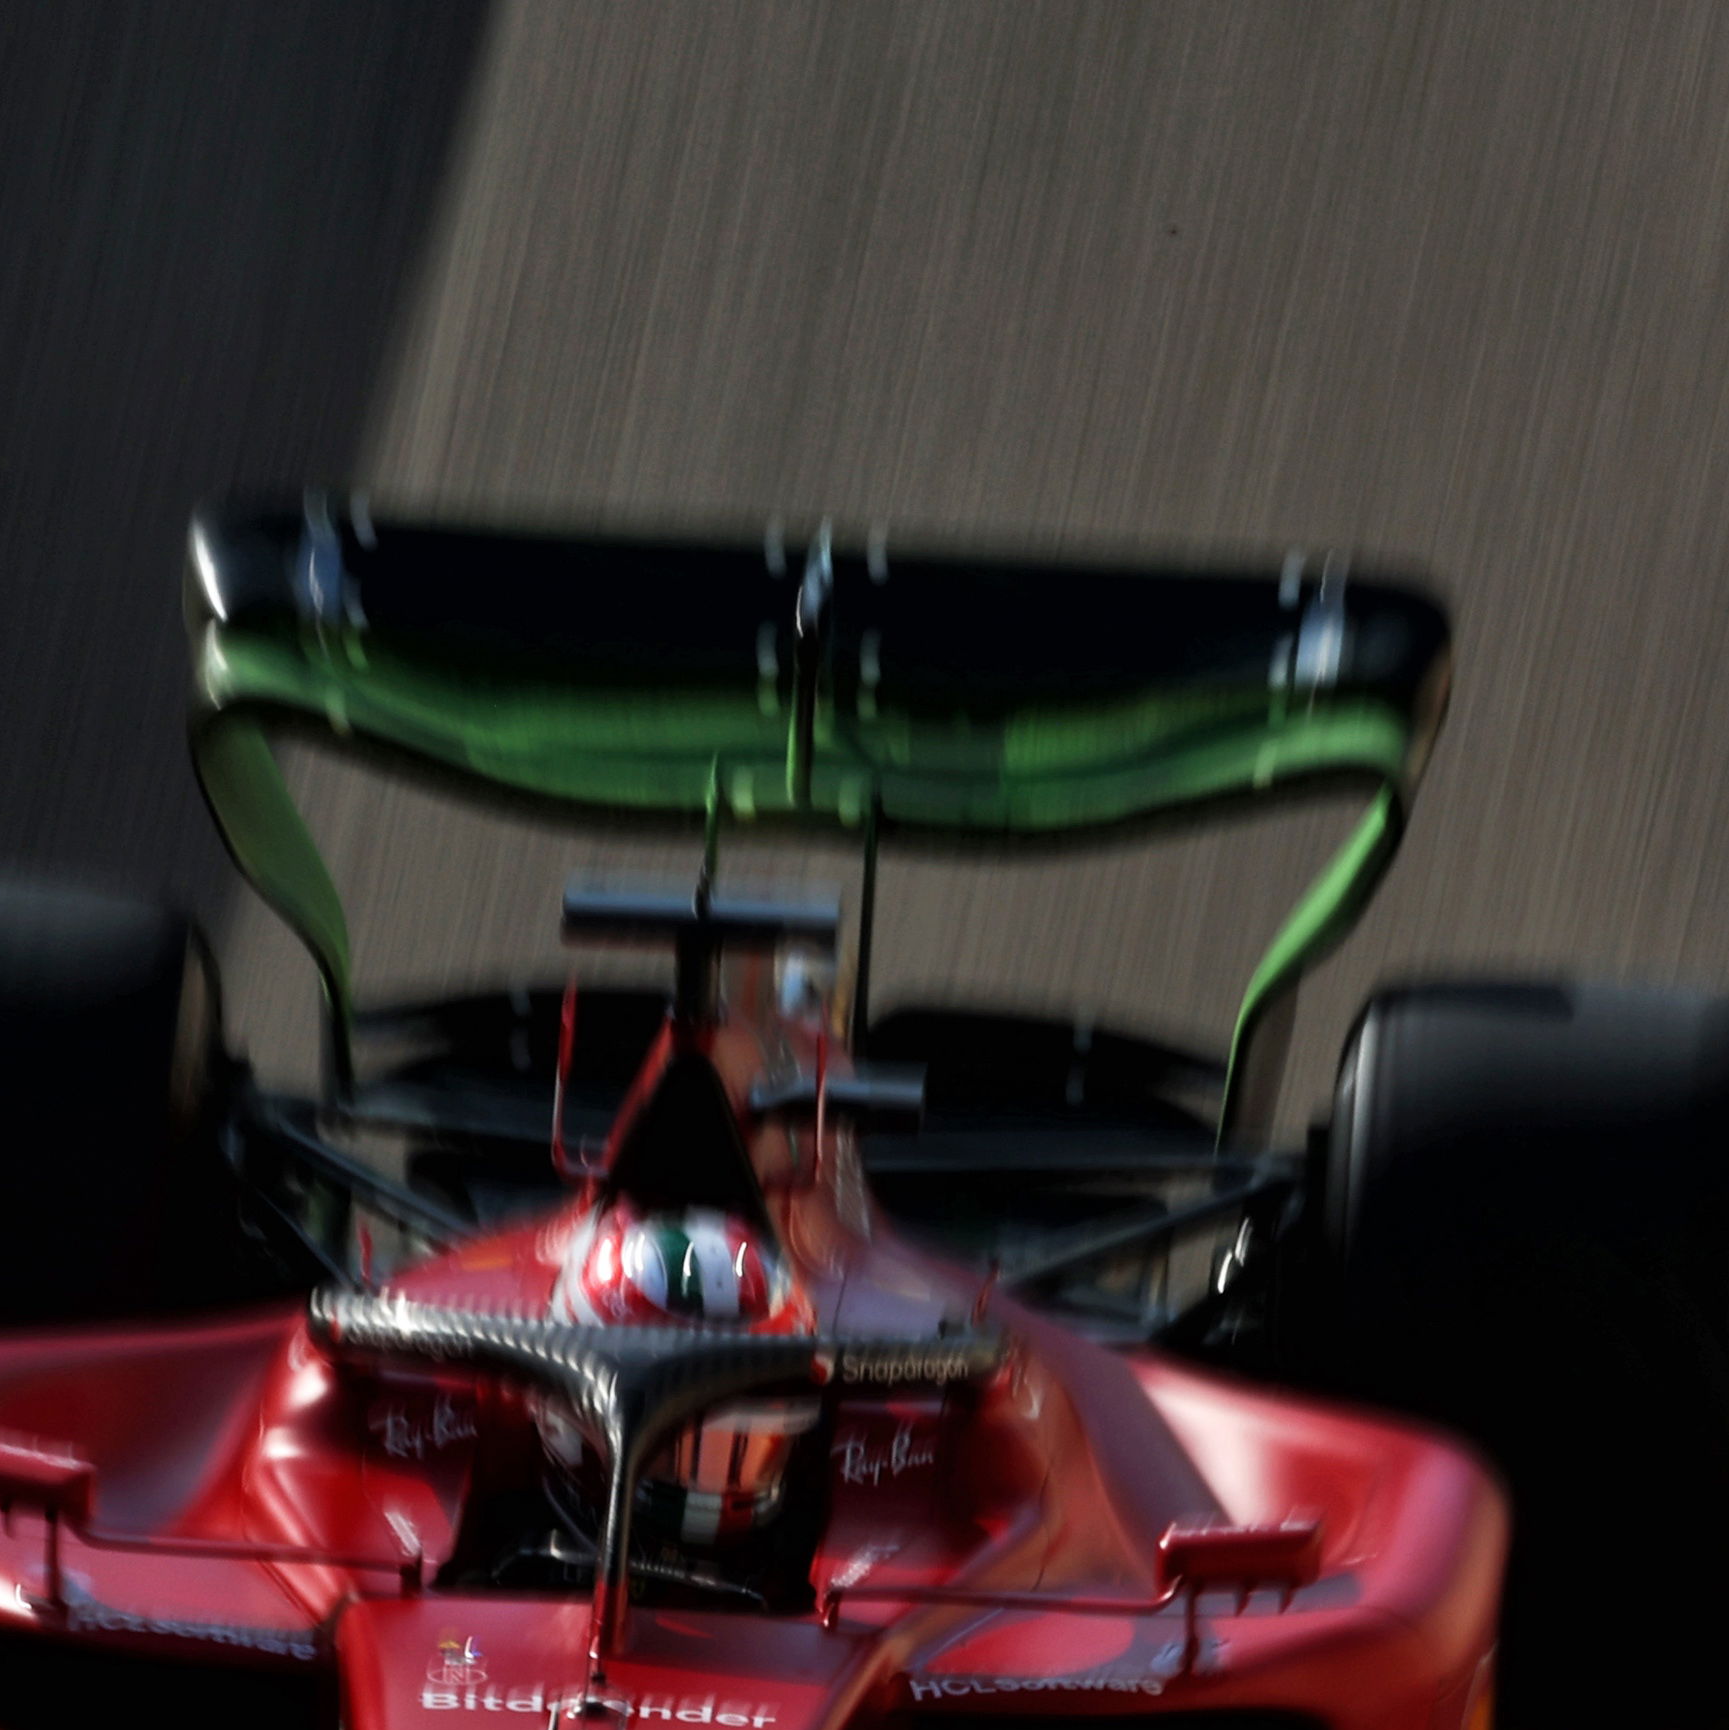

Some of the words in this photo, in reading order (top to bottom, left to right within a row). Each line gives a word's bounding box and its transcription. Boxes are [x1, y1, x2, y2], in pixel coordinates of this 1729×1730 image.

[843, 1353, 969, 1386] Snapdragon
[908, 1677, 1164, 1702] HCLSoftware
[422, 1690, 776, 1728] Bitdnder
